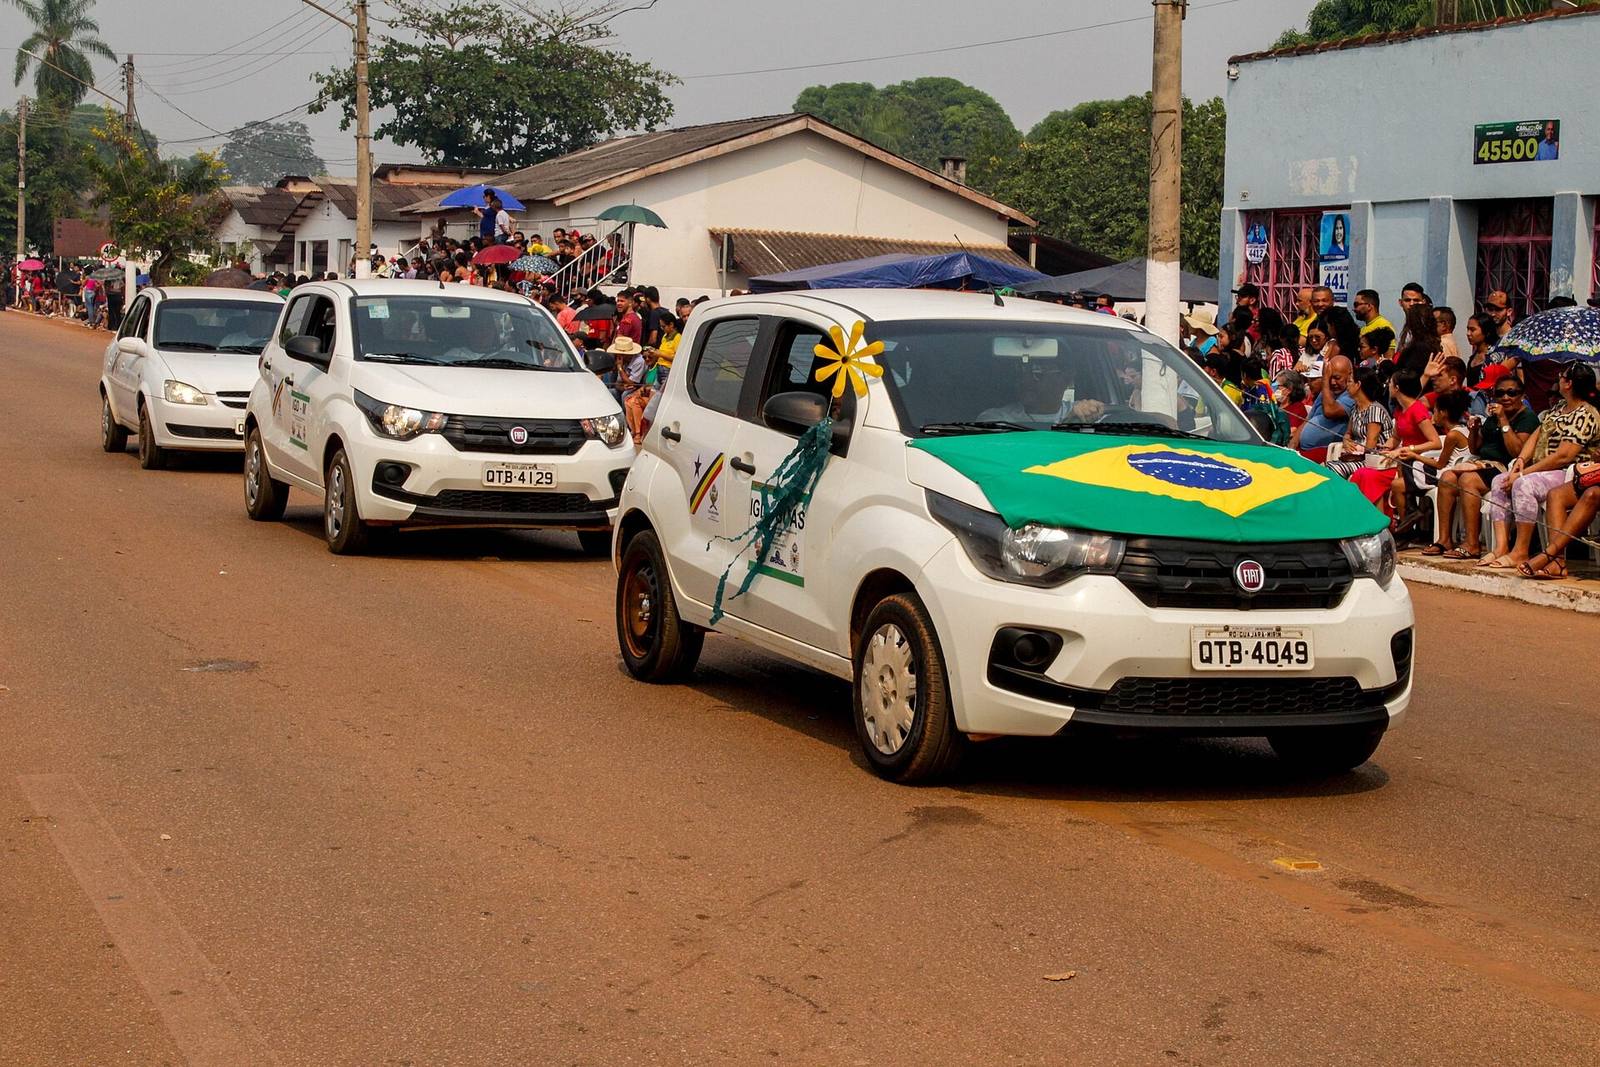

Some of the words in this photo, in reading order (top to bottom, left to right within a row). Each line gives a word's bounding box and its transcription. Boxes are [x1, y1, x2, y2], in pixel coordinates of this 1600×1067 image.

[1478, 137, 1538, 161] 45500
[776, 506, 806, 530] AS
[1242, 568, 1259, 583] FIAT
